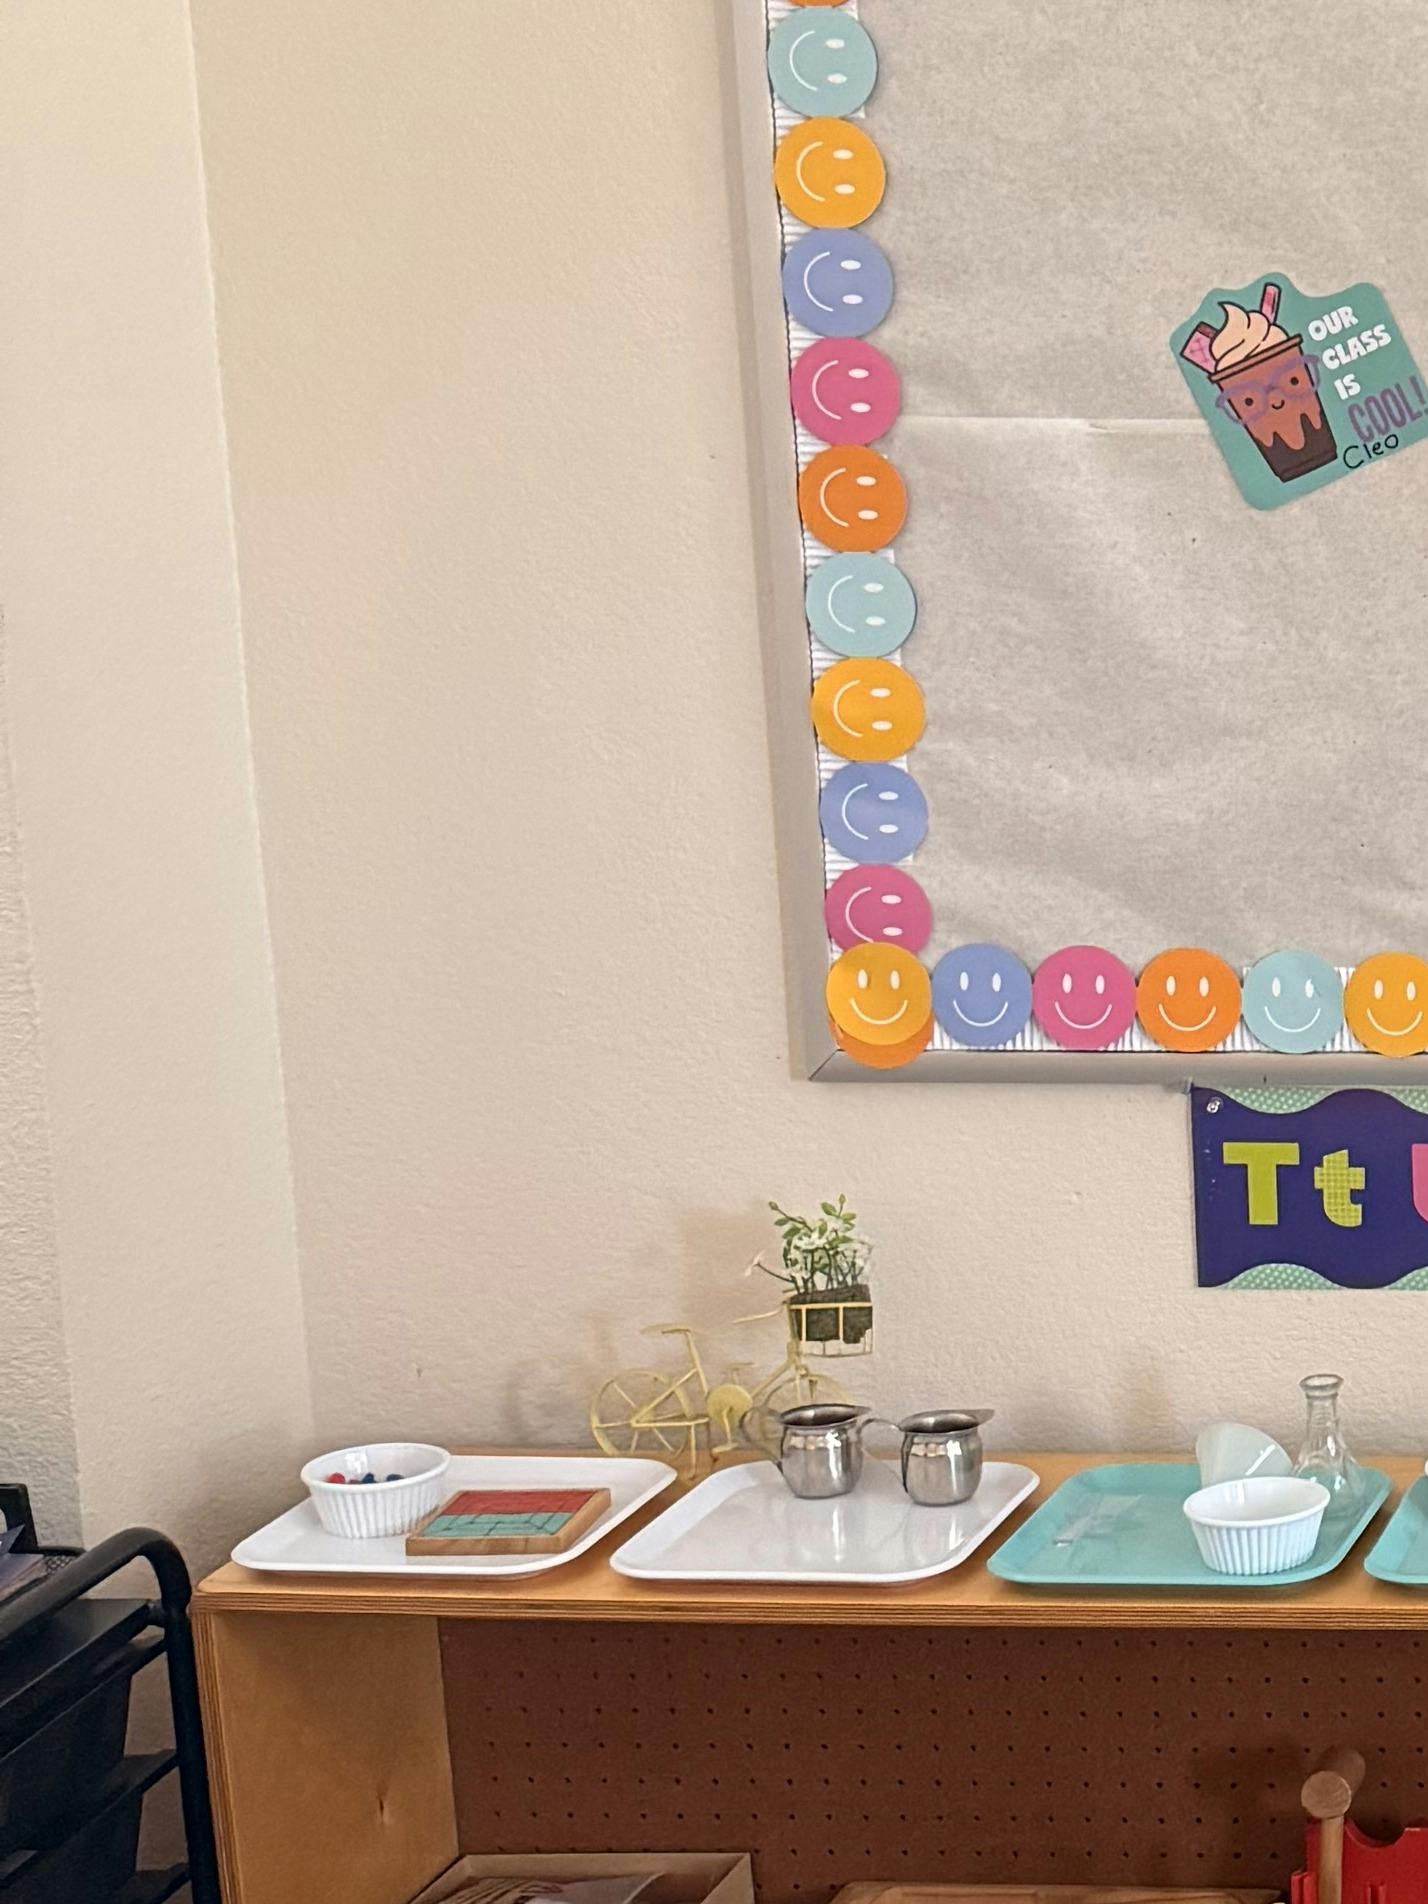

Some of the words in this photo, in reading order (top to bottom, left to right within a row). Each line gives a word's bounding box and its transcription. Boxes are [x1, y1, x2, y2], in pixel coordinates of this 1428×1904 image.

[1307, 306, 1358, 341] OUR
[1322, 324, 1392, 370] CLASS
[1334, 373, 1361, 400] IS
[1343, 434, 1399, 469] Cleo
[1223, 1143, 1367, 1227] Tt
